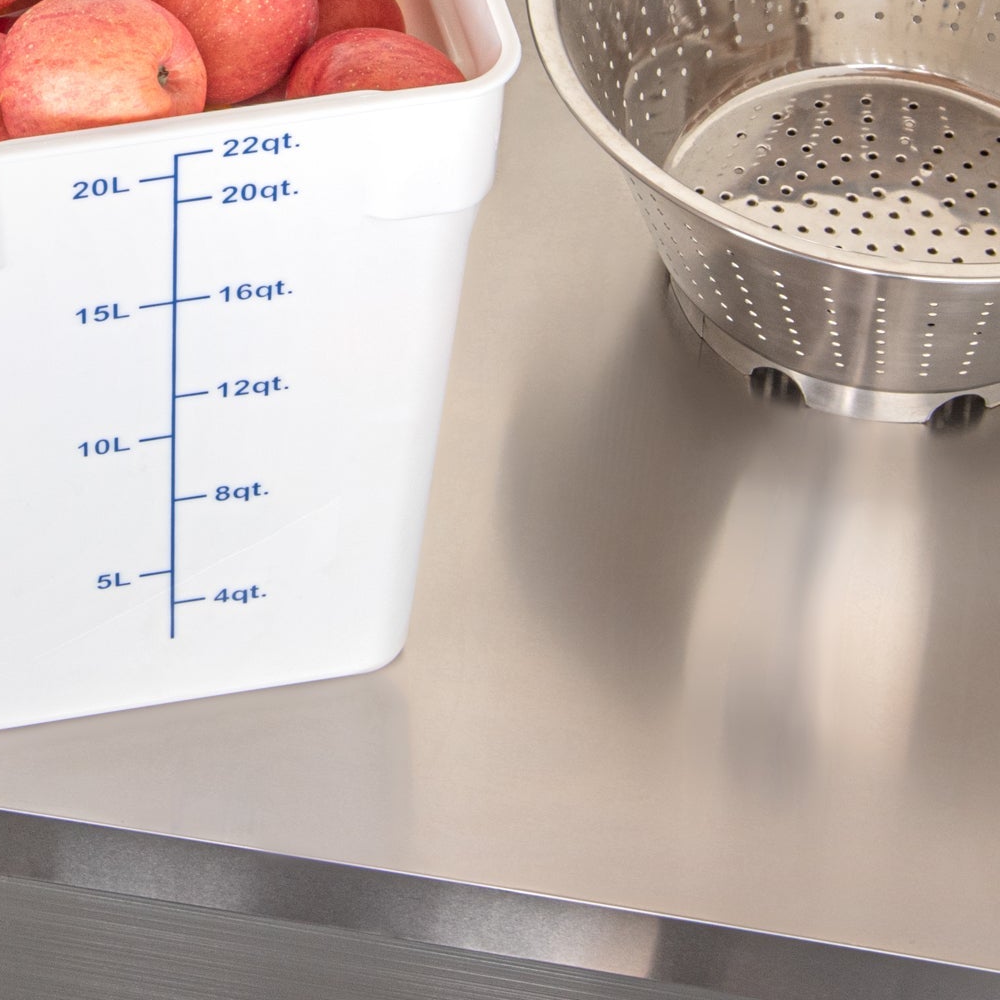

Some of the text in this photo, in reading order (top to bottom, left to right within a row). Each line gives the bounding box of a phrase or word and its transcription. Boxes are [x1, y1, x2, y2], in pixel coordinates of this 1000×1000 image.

[222, 132, 300, 158] 22qt.
[72, 176, 130, 200] 20L
[221, 179, 299, 205] 20qt.
[219, 280, 293, 303] 16qt.
[75, 303, 130, 325] 15L
[217, 376, 289, 398] 12qt.
[77, 436, 131, 458] 10L
[215, 482, 269, 502] 8qt.
[97, 572, 131, 590] 5L
[213, 584, 267, 604] 4qt.
